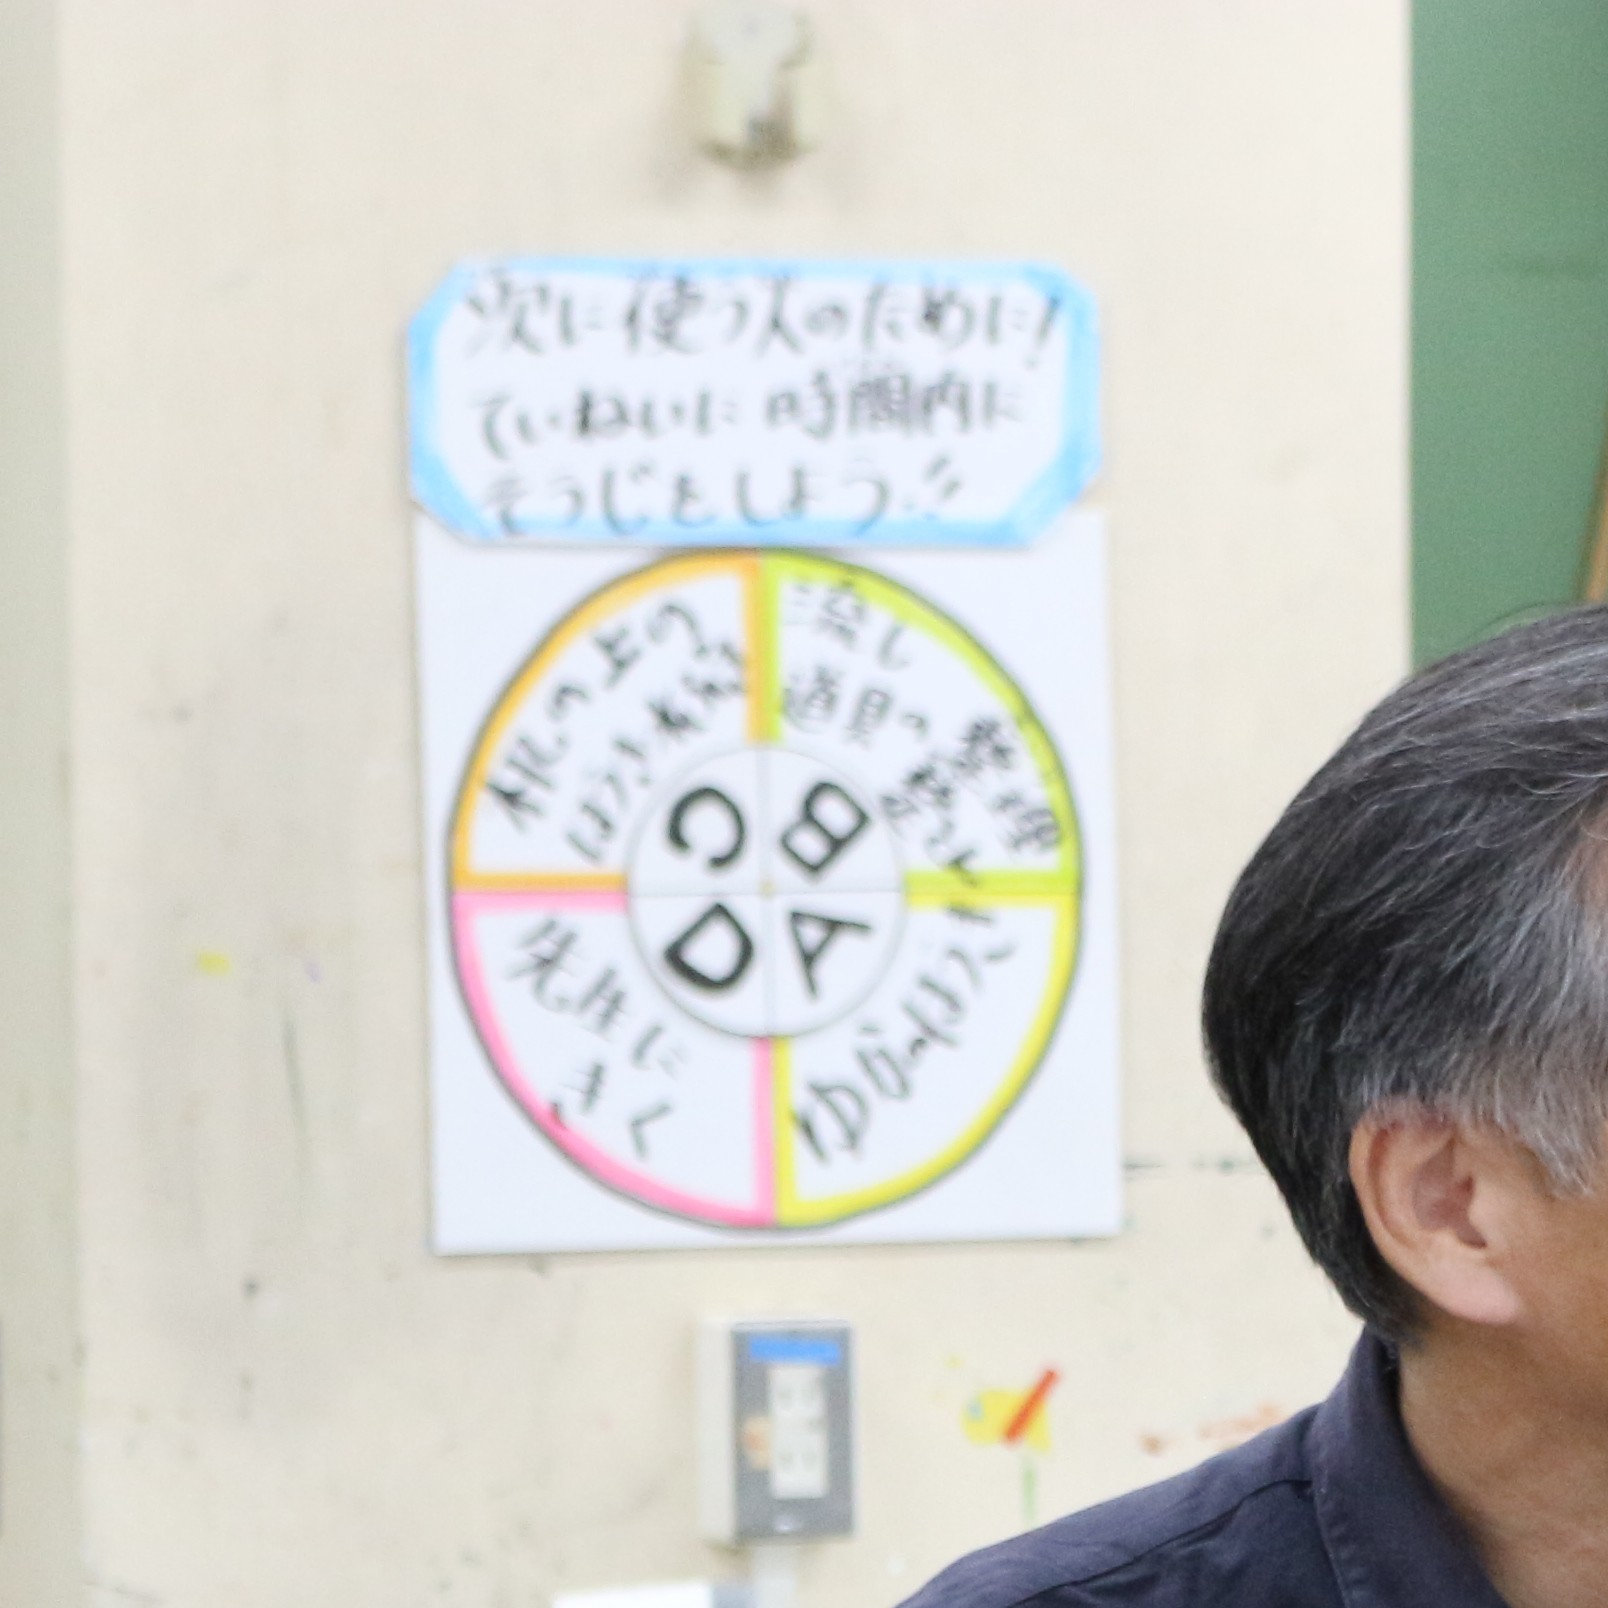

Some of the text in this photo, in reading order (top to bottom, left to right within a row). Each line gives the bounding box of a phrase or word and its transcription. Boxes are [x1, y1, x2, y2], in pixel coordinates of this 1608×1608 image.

[667, 785, 746, 869] C
[779, 781, 869, 876] B
[663, 901, 754, 991] D
[789, 909, 872, 998] A
